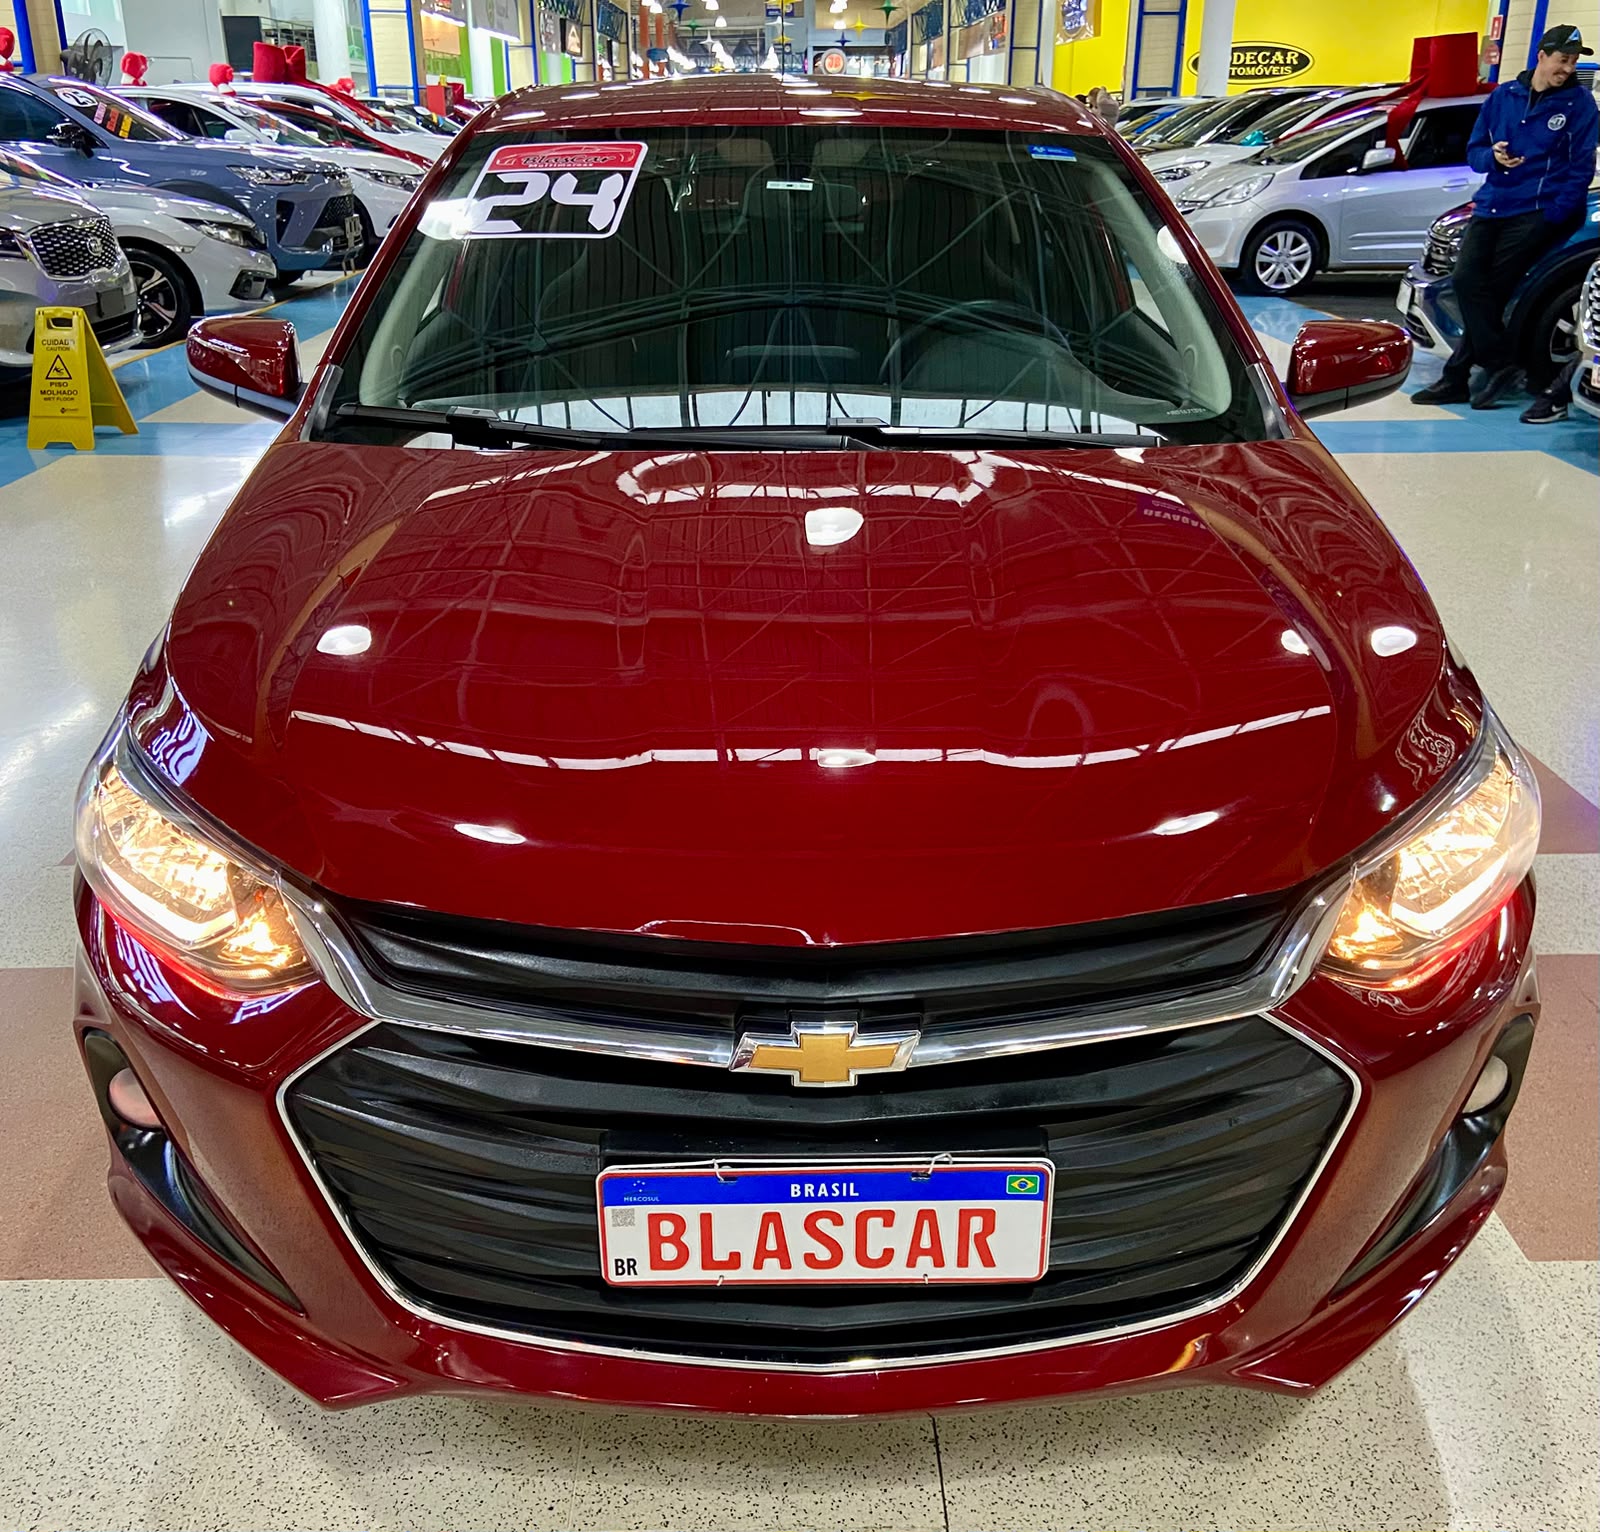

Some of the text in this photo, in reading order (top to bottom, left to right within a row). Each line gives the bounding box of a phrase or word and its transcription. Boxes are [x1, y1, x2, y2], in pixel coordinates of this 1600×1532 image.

[1232, 51, 1299, 65] DECAR
[1229, 65, 1292, 76] TOMÓVEIS
[468, 172, 624, 232] 24
[790, 1181, 859, 1198] BRASIL
[646, 1208, 997, 1271] BLASCAR
[614, 1258, 638, 1276] BR
